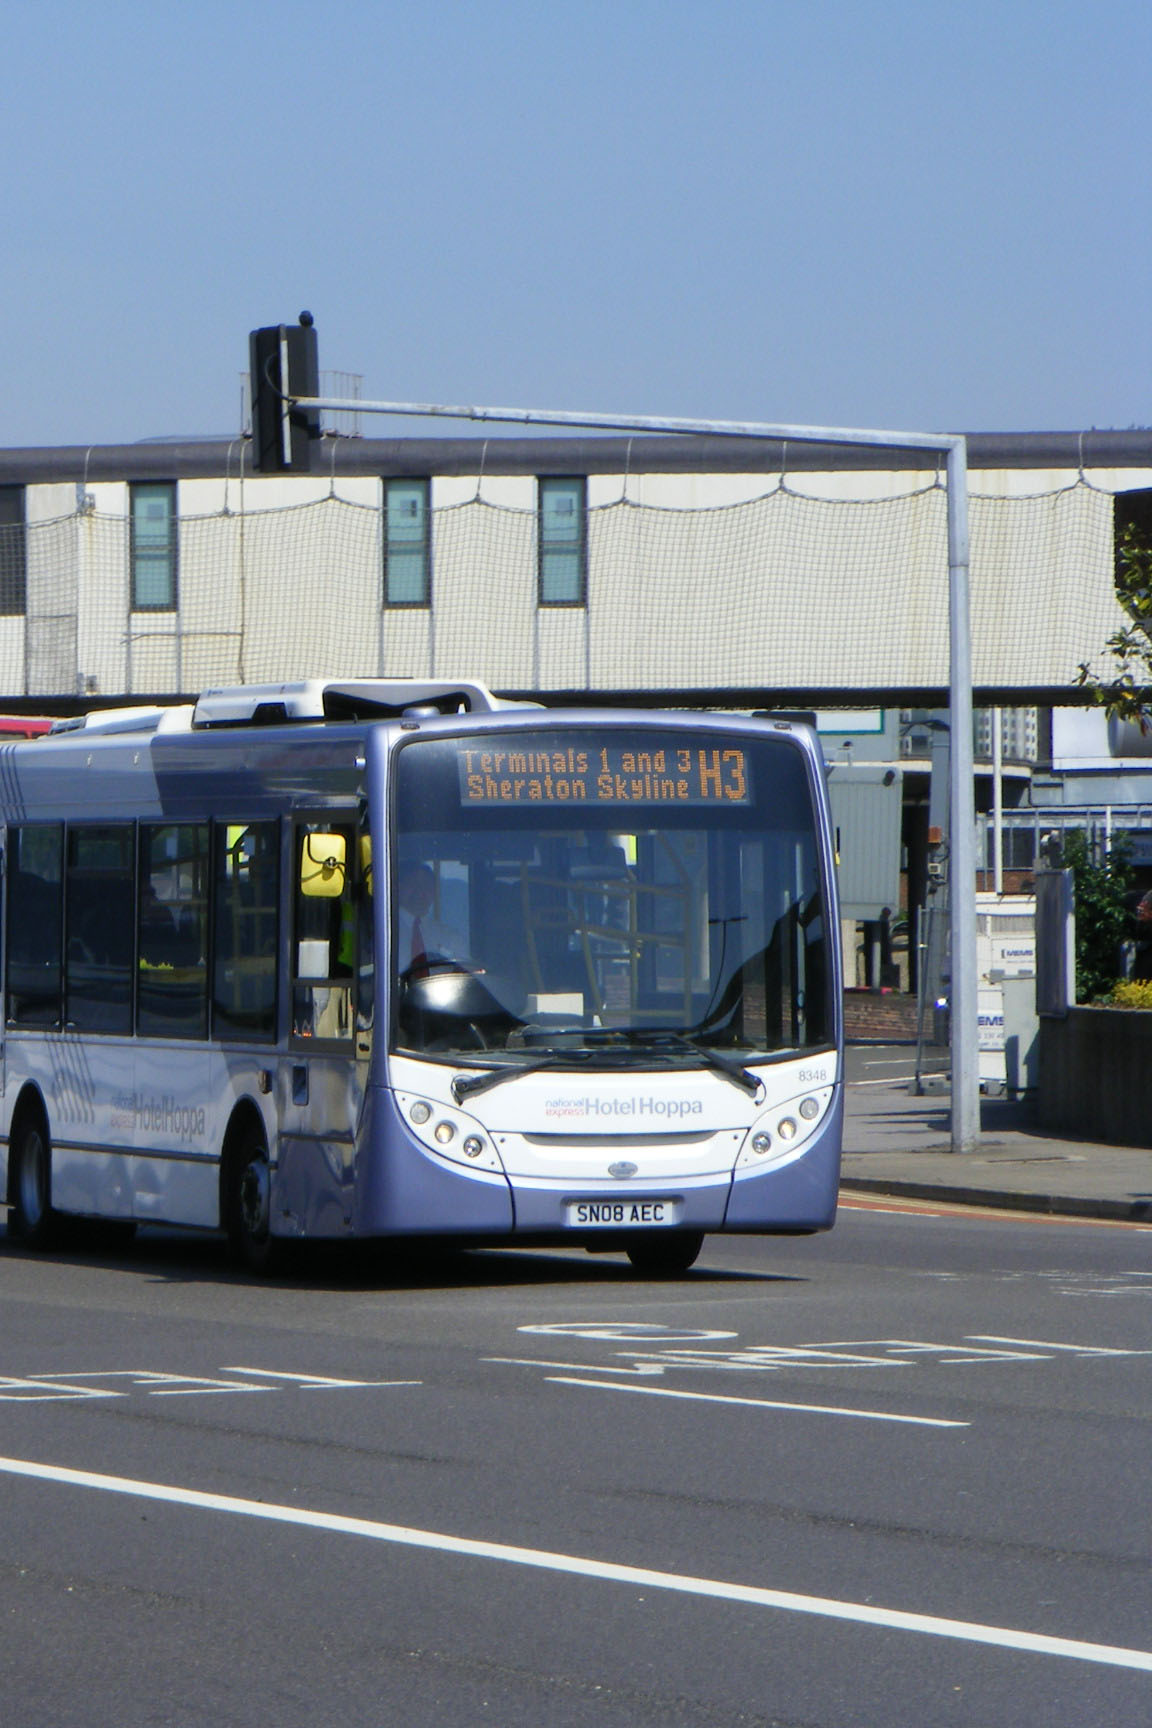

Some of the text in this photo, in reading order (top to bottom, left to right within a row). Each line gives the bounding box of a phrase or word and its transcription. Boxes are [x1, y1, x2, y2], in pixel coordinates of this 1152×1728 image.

[464, 748, 691, 773] Terminals 1 and 3
[698, 750, 746, 799] H3
[467, 774, 689, 799] Sheraton Skyline
[977, 1016, 1004, 1026] EMS
[799, 1069, 827, 1081] 8348
[545, 1098, 584, 1108] national
[545, 1107, 584, 1117] express
[585, 1097, 702, 1118] Hotel Hoppa
[577, 1204, 664, 1222] SN08 AEC
[478, 1335, 1152, 1374] TERM
